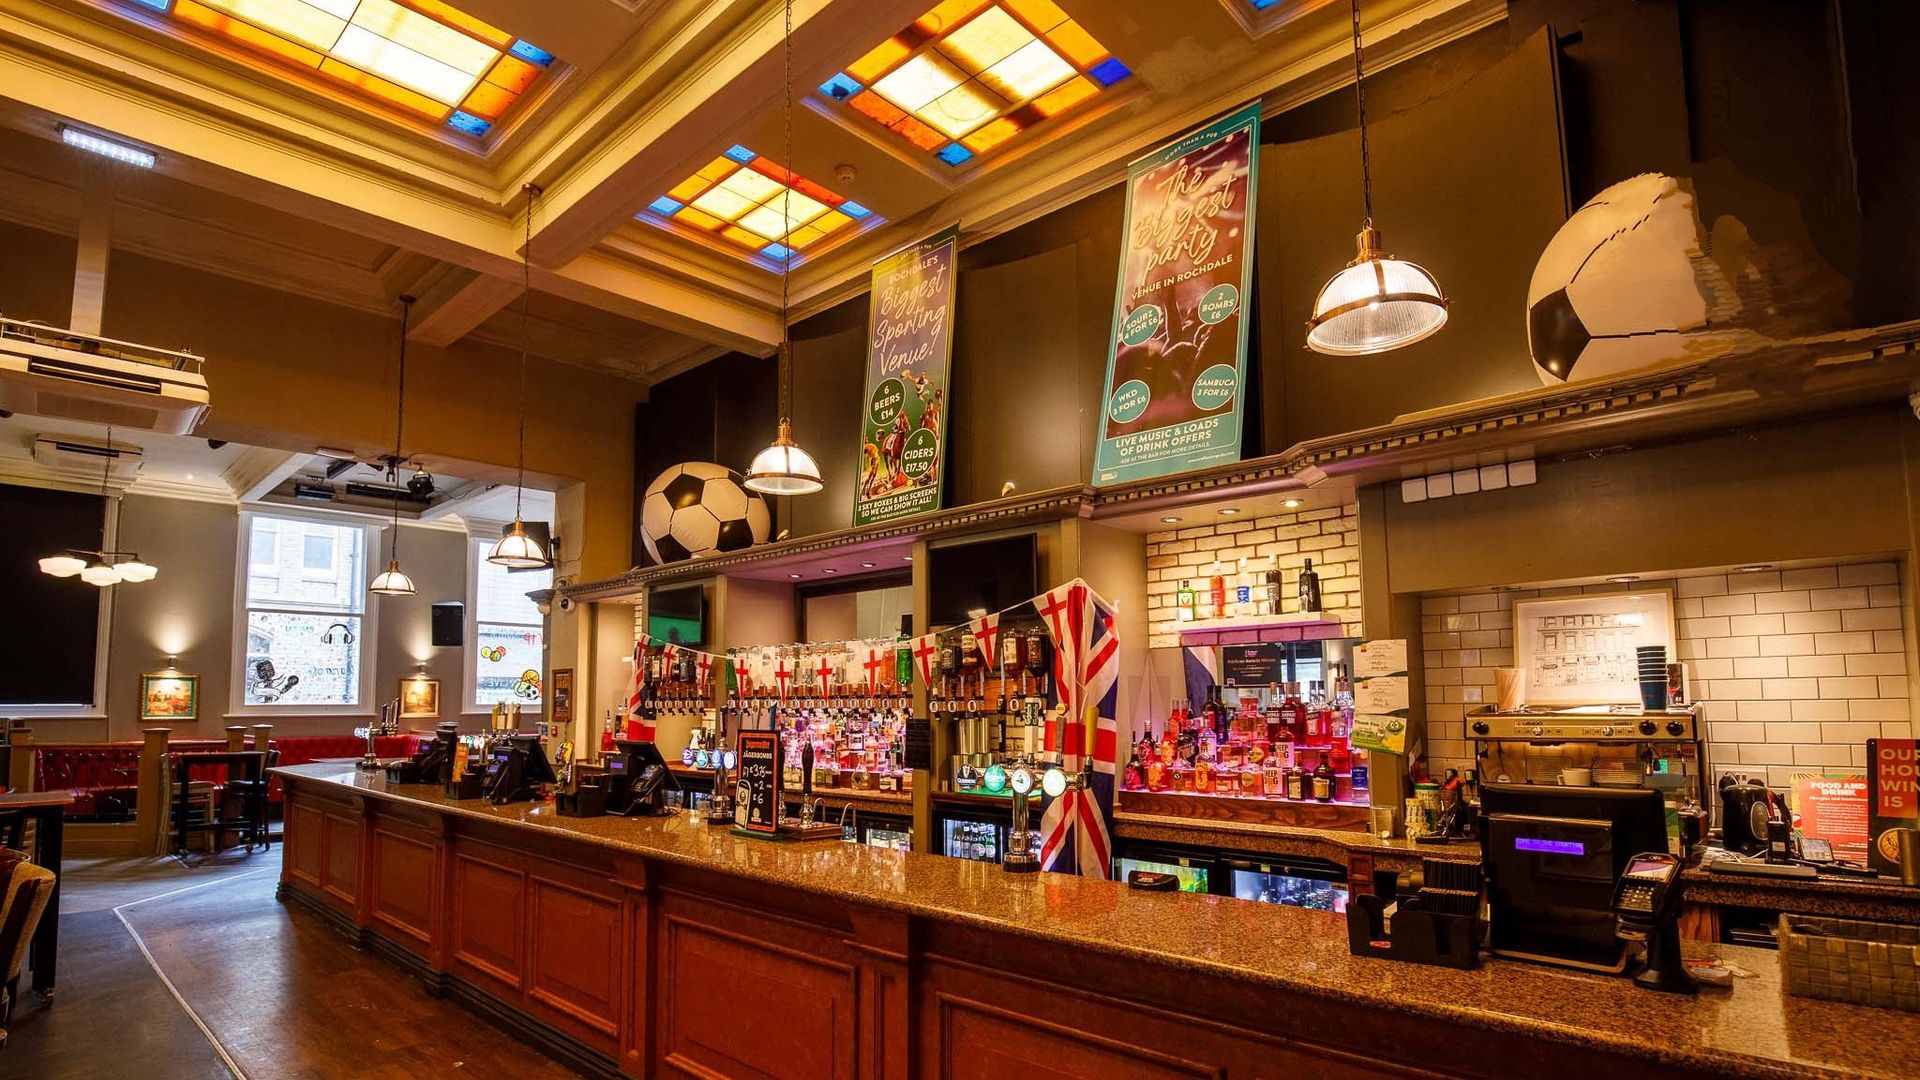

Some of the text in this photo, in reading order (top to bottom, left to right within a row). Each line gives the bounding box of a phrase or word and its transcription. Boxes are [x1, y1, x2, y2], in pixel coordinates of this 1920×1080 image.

[1156, 165, 1204, 210] The
[1134, 172, 1237, 249] Biggest
[1141, 225, 1218, 287] party
[1131, 253, 1234, 300] VENUE IN ROCHDALE
[881, 263, 947, 320] Biggest
[1217, 292, 1225, 300] 2
[1201, 298, 1235, 313] BOMBS
[1126, 309, 1154, 331] SOURZ
[1210, 311, 1221, 320] £6
[874, 304, 947, 353] Sporting
[1130, 322, 1147, 337] FOR
[1148, 317, 1158, 327] £6
[880, 335, 938, 376] Venue!
[884, 385, 890, 395] 6
[1197, 379, 1235, 387] SAMBUCA
[1118, 388, 1138, 403] WKD
[1202, 388, 1219, 396] FOR
[1219, 388, 1229, 396] £6
[874, 392, 900, 411] BEERS
[1111, 395, 1147, 416] 3 FOR £6
[881, 408, 894, 420] £14
[918, 435, 923, 445] 6
[1116, 418, 1219, 448] LIVE MUSIC & LOADS
[1120, 430, 1212, 457] OF DRINK OFFERS
[904, 447, 934, 460] CIDERS
[1148, 451, 1159, 459] BAR
[1159, 449, 1171, 457] FOR
[1171, 446, 1188, 455] MORE
[905, 461, 928, 473] £17.50
[862, 501, 873, 510] SKY
[874, 498, 893, 508] BOXES
[899, 494, 910, 503] BIG
[909, 487, 937, 500] SCREENS
[880, 505, 894, 513] CAN
[894, 500, 912, 511] SHOW
[912, 498, 919, 506] IT
[919, 496, 932, 505] ALL!
[1810, 782, 1867, 790] FOOD AND
[1821, 788, 1857, 796] DRINK
[1884, 796, 1903, 808] IS
